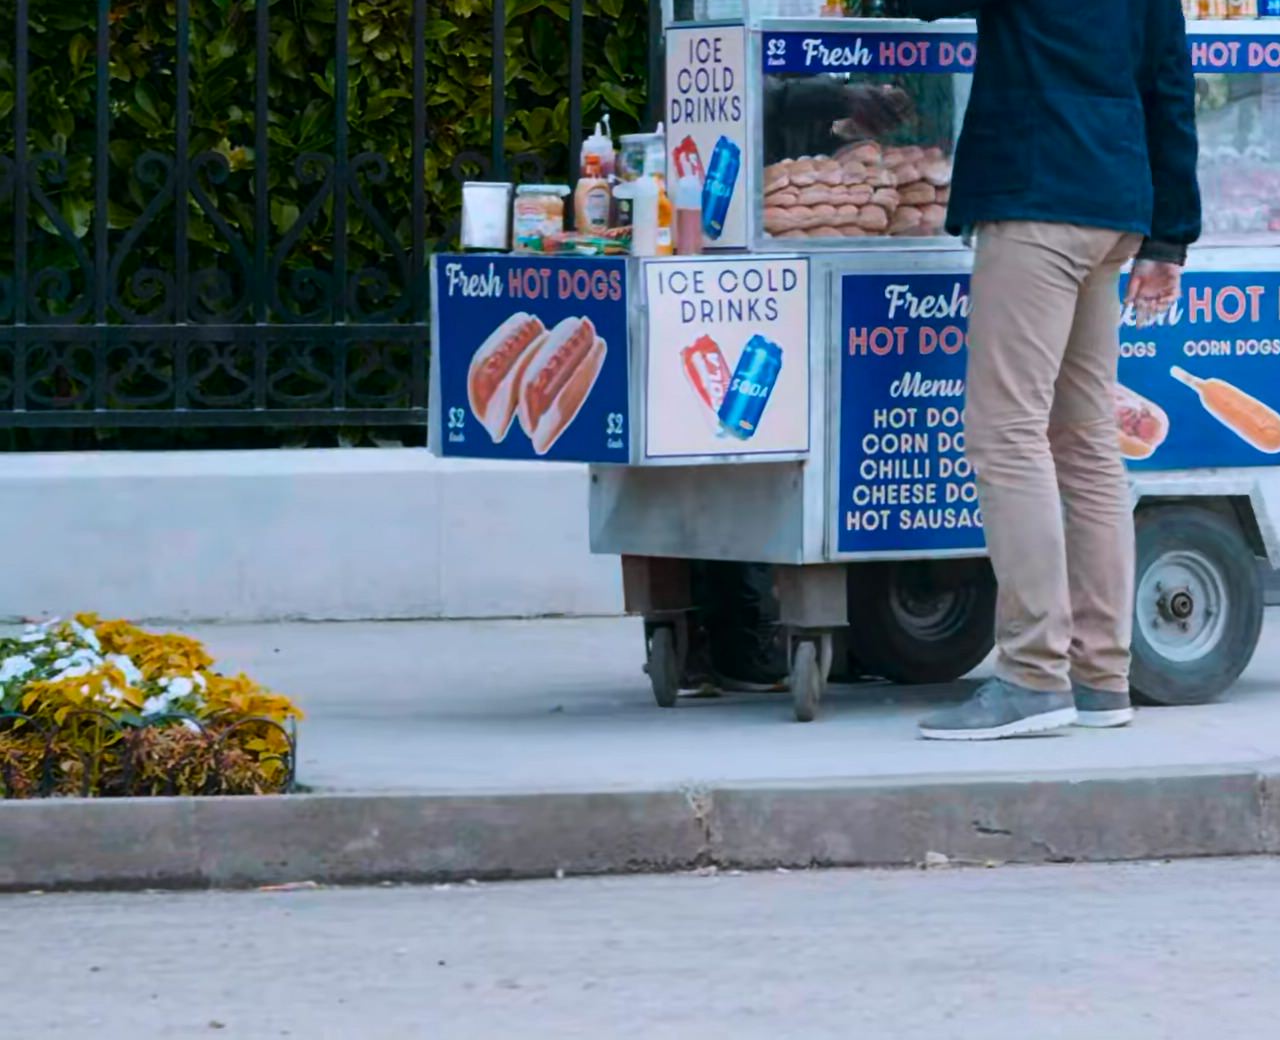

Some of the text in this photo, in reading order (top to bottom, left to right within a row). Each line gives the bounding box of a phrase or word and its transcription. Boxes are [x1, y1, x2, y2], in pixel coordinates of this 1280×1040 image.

[689, 37, 722, 64] ICE
[766, 39, 786, 55] $2
[802, 37, 977, 67] Fresh HOT DO
[1191, 41, 1242, 67] HOT
[677, 66, 734, 95] COLD
[671, 95, 742, 125] DRINKS
[445, 262, 623, 302] Fresh HOT DOGS
[658, 268, 797, 295] ICE COLD
[680, 297, 779, 324] DRINKS
[884, 282, 974, 320] Fresh
[1188, 285, 1265, 324] HOT
[848, 325, 969, 357] HOT DO
[1120, 341, 1157, 358] OGS
[1183, 339, 1232, 357] CORN
[889, 371, 965, 399] Menu
[448, 406, 466, 429] $2
[606, 412, 624, 435] $2
[873, 406, 966, 430] HOT DO
[861, 431, 966, 455] CORN DO
[859, 456, 979, 481] CHILLI DO
[852, 481, 978, 507] CHEESE DO
[846, 507, 984, 532] HOT SAUSAG
